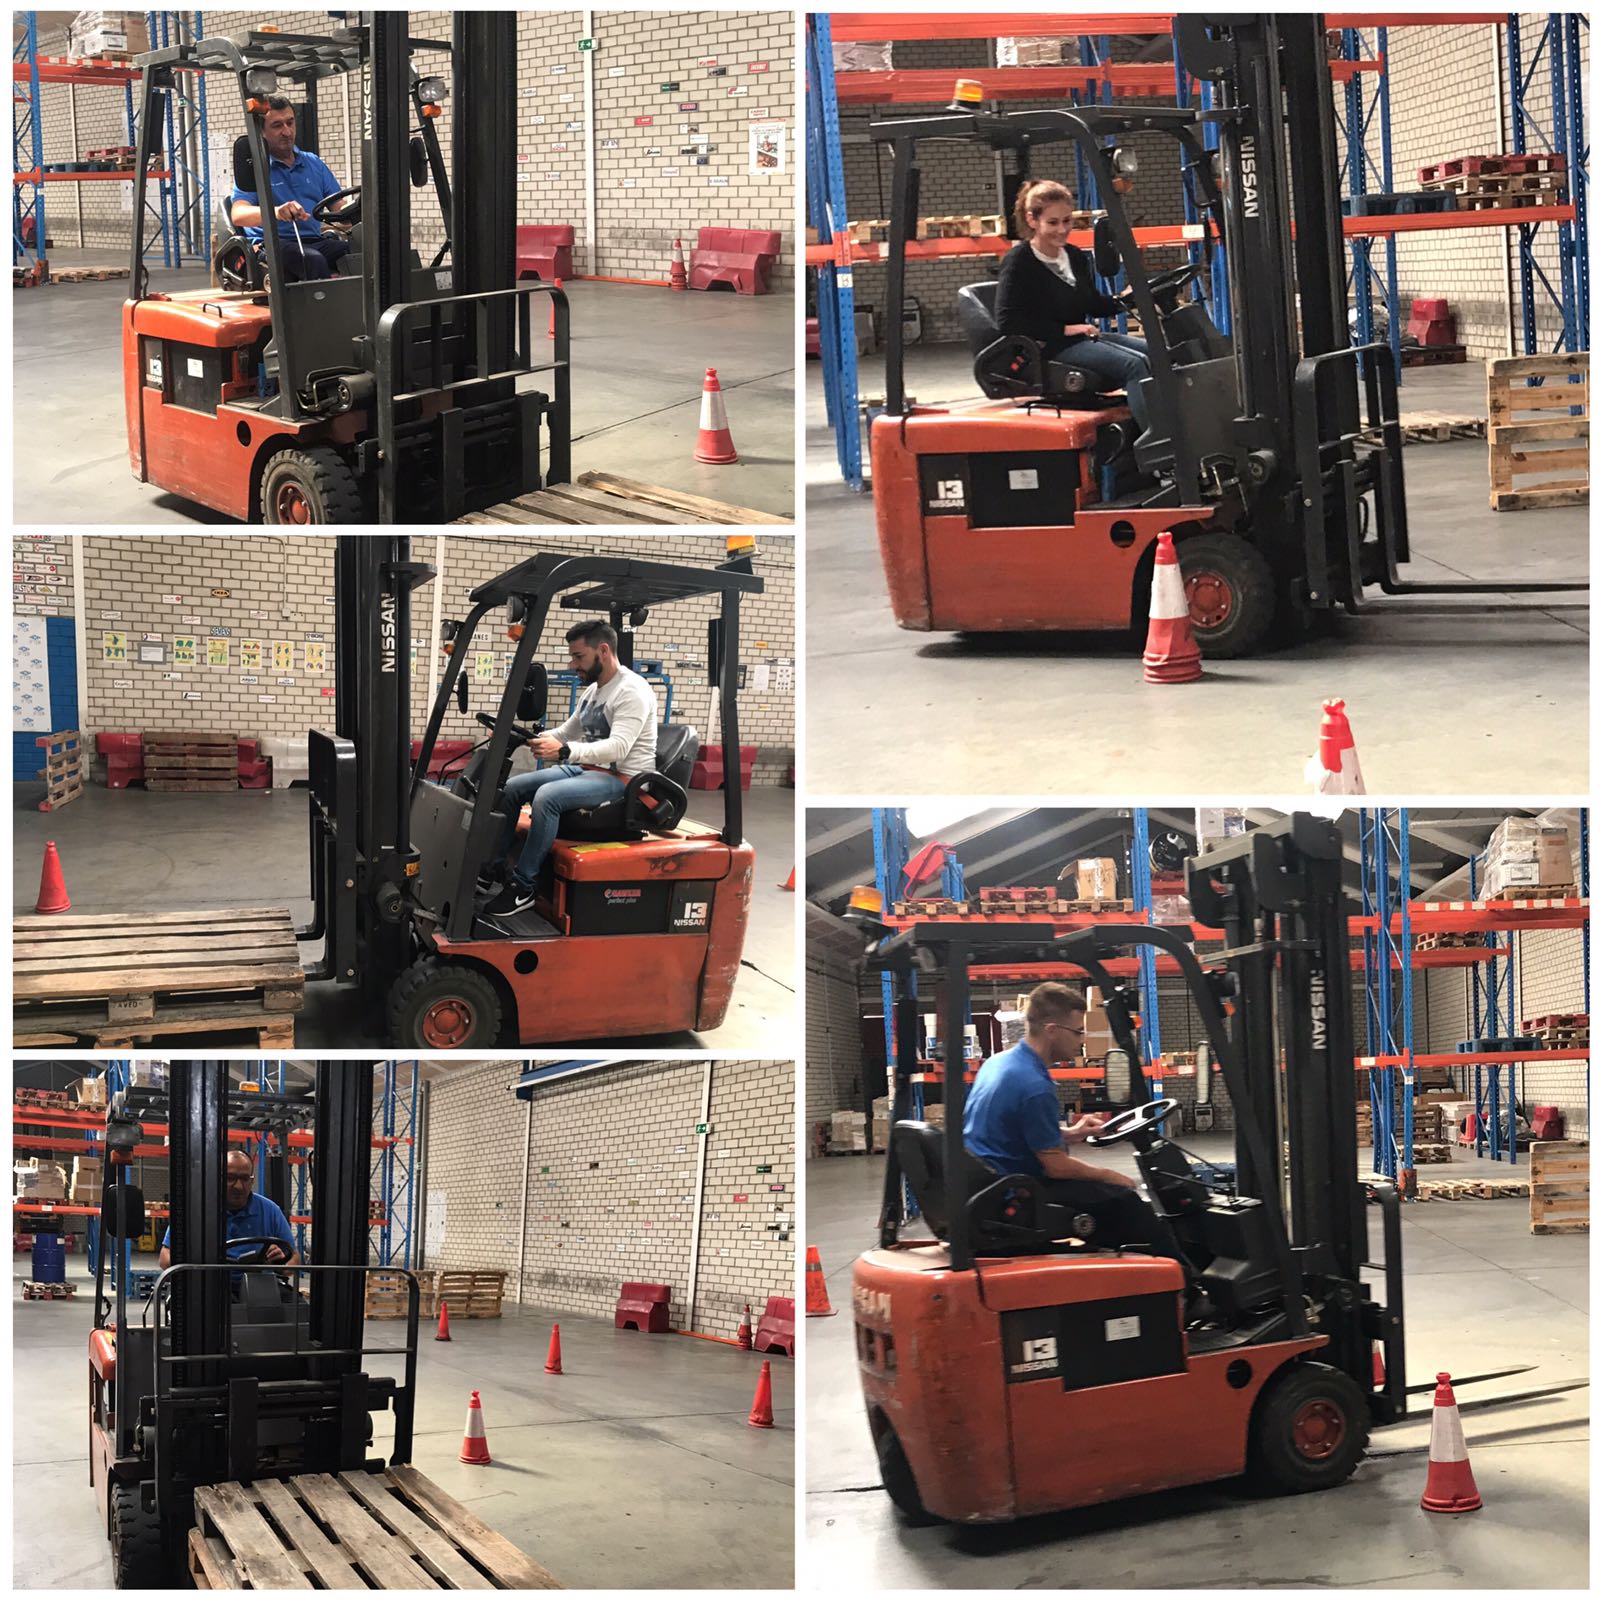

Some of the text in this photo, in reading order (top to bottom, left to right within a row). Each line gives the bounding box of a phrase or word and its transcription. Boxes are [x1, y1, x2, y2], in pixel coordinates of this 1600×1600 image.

[1240, 135, 1259, 218] NISSAN
[937, 480, 964, 499] 13
[929, 499, 965, 508] NISSAN
[381, 593, 395, 672] NISSAN
[684, 902, 708, 919] 13
[674, 918, 706, 927] NISSAN
[1310, 969, 1327, 1050] NISSAN
[1023, 1337, 1058, 1362] 13
